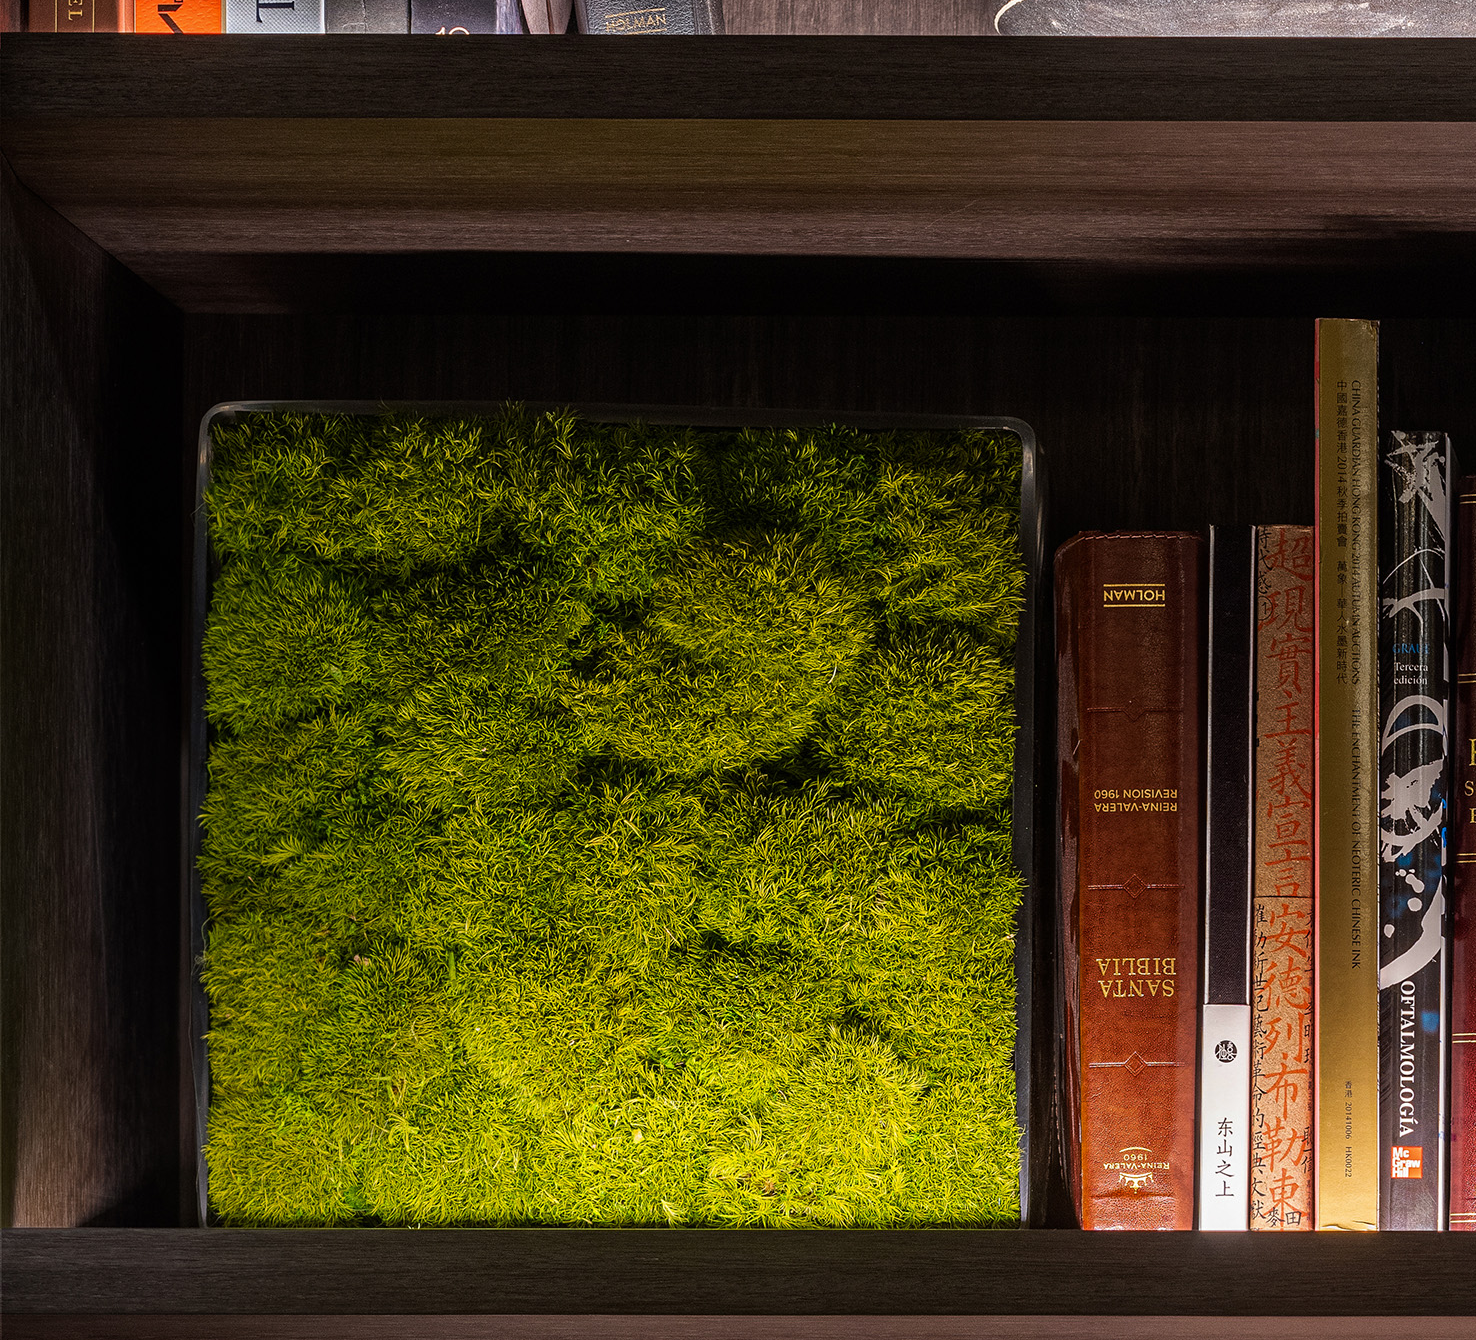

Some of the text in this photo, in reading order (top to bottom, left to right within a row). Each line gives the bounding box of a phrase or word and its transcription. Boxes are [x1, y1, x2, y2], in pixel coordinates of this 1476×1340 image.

[1336, 456, 1347, 483] 2014
[1104, 587, 1165, 602] HOLMAN
[1351, 381, 1362, 969] CHINA GUARDIAN HONG KONG 2014 AUTUMN AUCTIONS THE ENCHANTMENT OF NEOTERIC CHINESE INK
[1394, 675, 1428, 685] edición
[1094, 803, 1178, 811] REINA-VALERA
[1097, 957, 1176, 975] BIBLIA
[1101, 979, 1175, 997] SANTA
[1399, 980, 1418, 1138] OFTALMOLOGÍA
[1345, 1081, 1352, 1098] 香港
[1216, 1117, 1234, 1197] 东山之上
